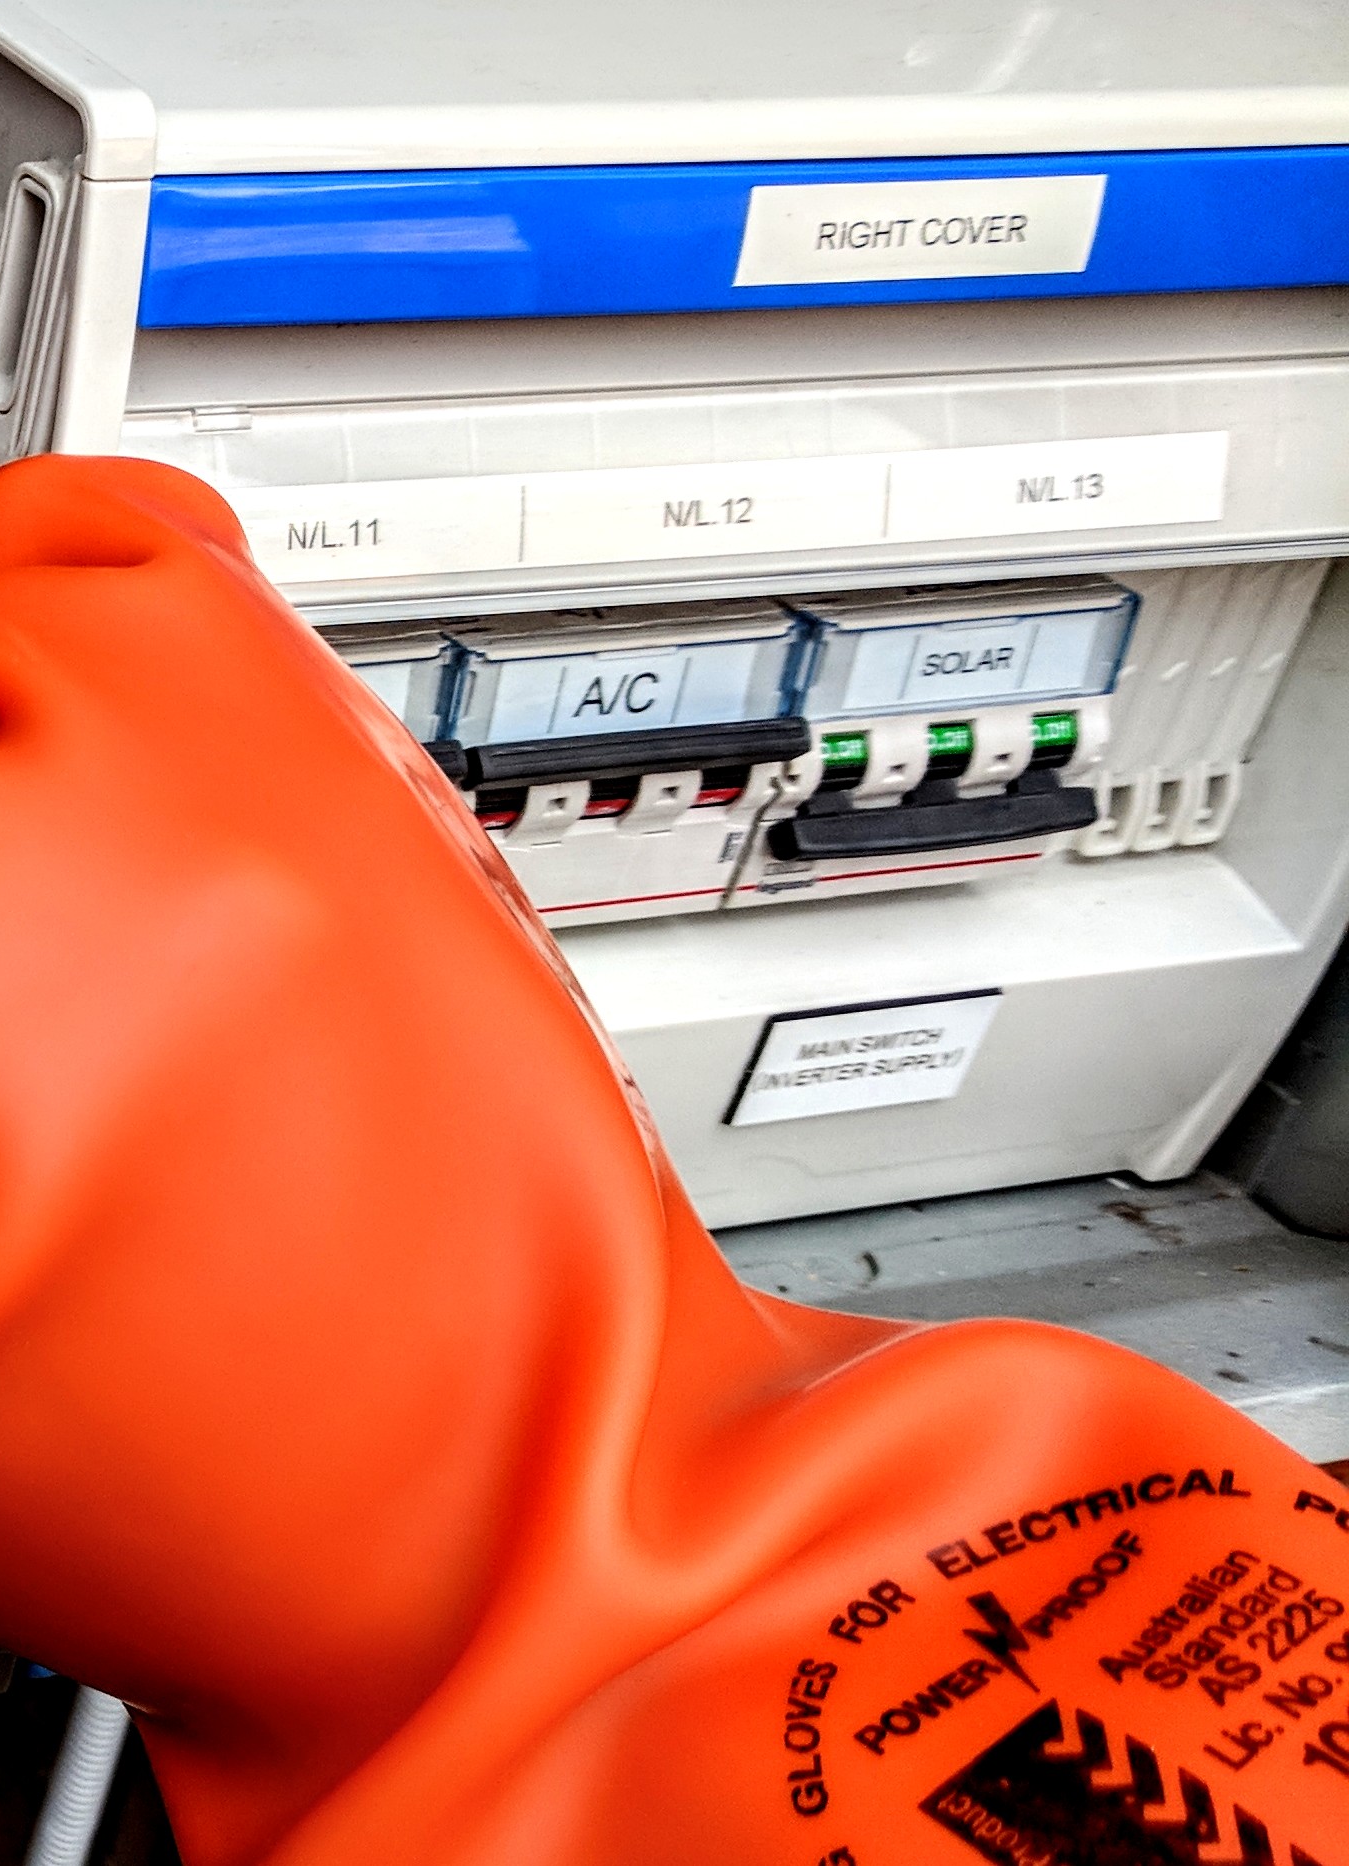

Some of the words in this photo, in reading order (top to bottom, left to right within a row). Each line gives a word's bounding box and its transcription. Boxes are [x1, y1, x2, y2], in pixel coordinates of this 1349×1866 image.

[816, 219, 915, 250] RIGHT
[921, 215, 1028, 246] COVER
[664, 496, 754, 528] N/L.12
[1016, 474, 1103, 504] N/L.13
[288, 518, 383, 551] N/L.11
[921, 645, 1014, 678] SOLAR
[573, 672, 659, 719] A/C
[797, 1039, 849, 1061] MAIN
[857, 1028, 945, 1054] SWITCH
[1099, 1549, 1261, 1685] Australian
[1143, 1564, 1302, 1690] Standard
[784, 1658, 838, 1817] GLOVES
[828, 1579, 916, 1644] FOR
[926, 1469, 1251, 1579] ELECTRICAL
[853, 1658, 1002, 1756] POWER
[1022, 1529, 1144, 1640] PROOF
[1198, 1654, 1262, 1708] AS
[1247, 1588, 1345, 1664] 2225
[1203, 1721, 1285, 1772] Lic.
[1263, 1673, 1343, 1720] No.
